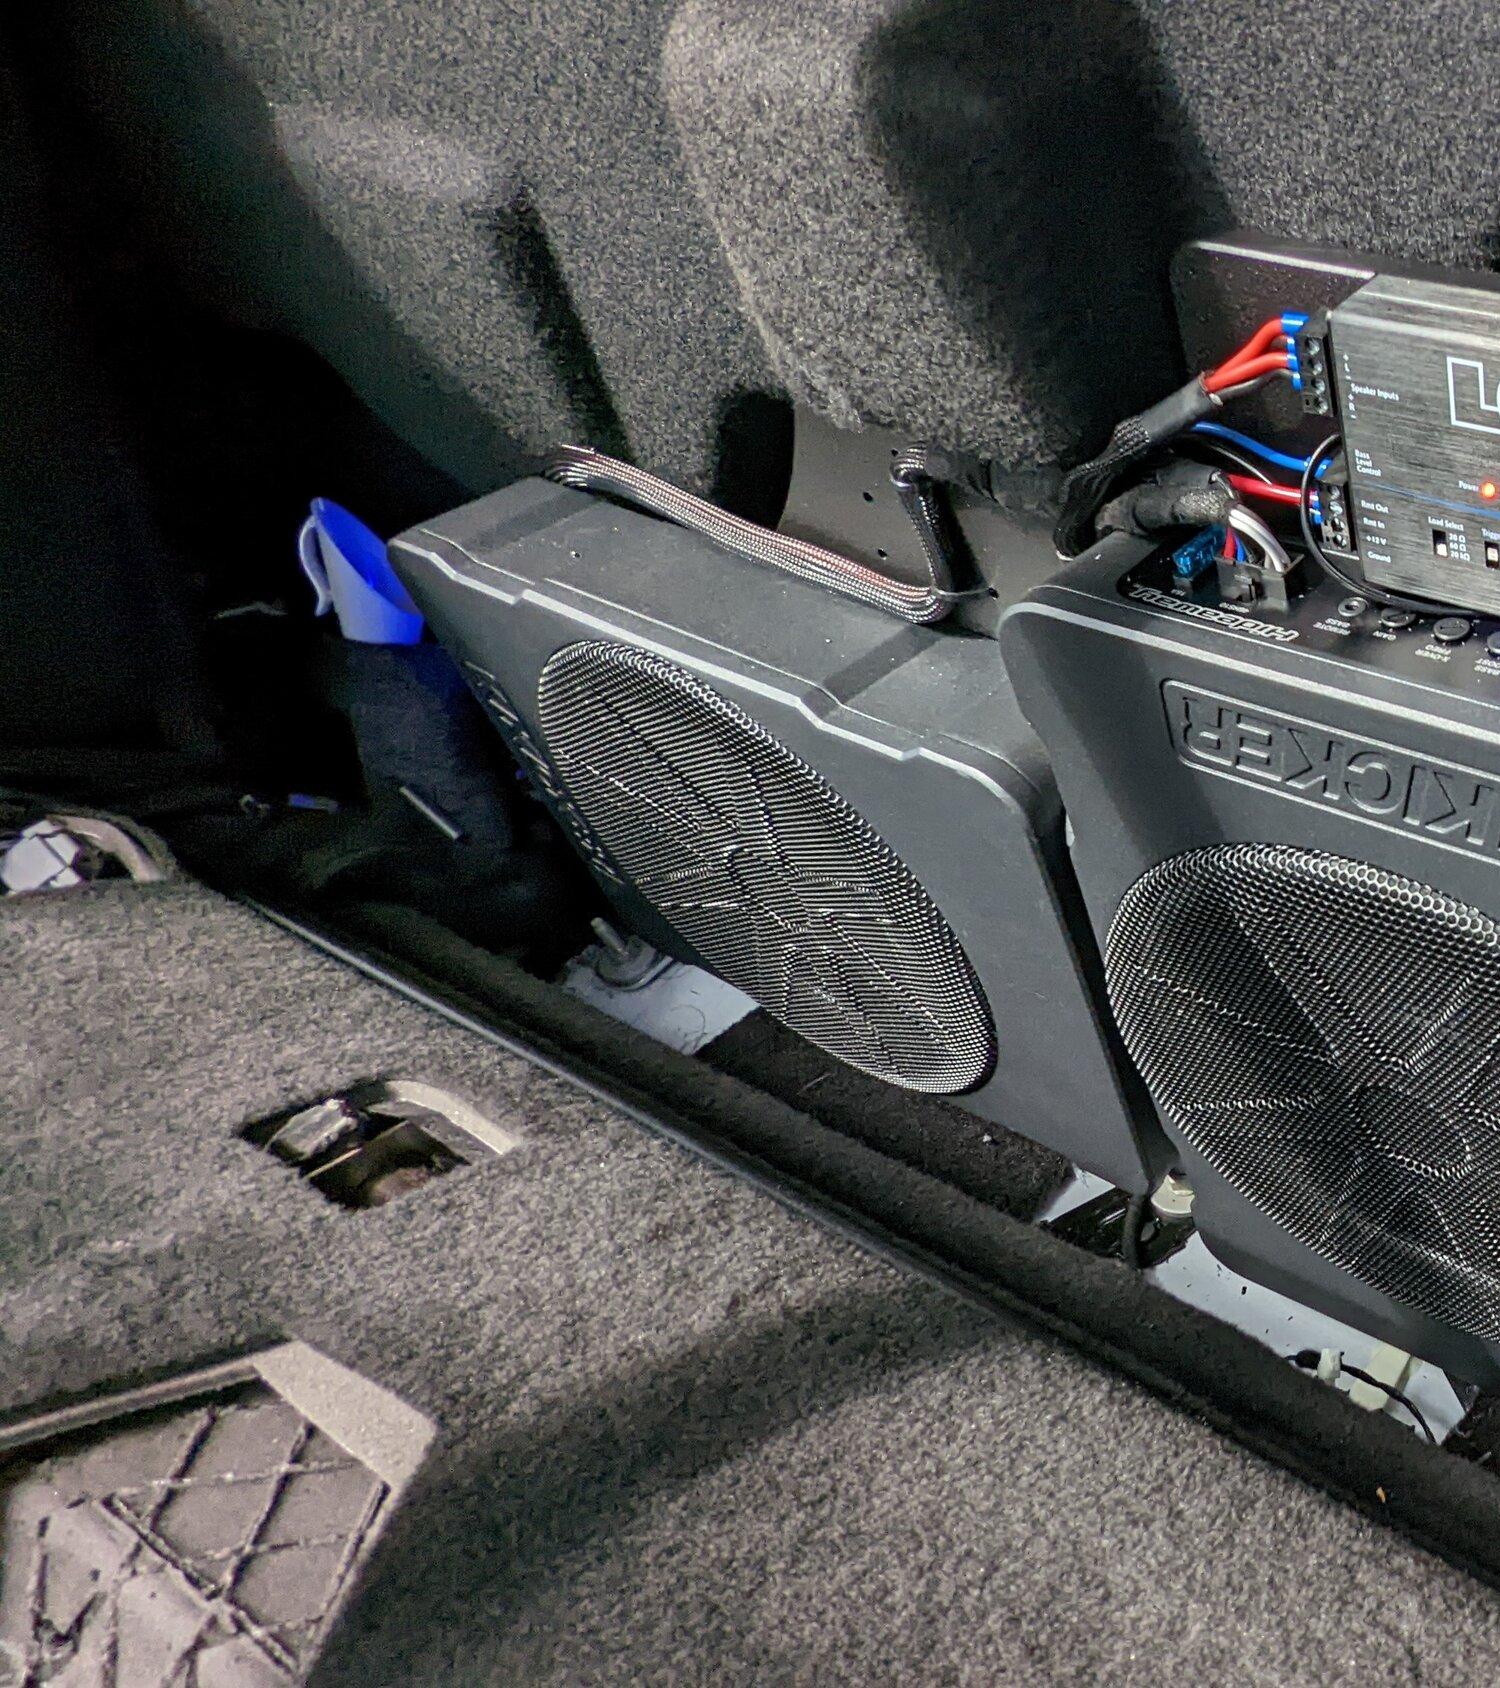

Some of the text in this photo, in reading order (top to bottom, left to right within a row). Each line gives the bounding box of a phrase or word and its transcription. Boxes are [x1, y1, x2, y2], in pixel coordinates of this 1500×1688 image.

[1350, 383, 1400, 401] Speaker Inputs
[1354, 449, 1370, 460] Bass
[1356, 458, 1372, 467] Level
[1356, 465, 1382, 477] Control
[1458, 480, 1480, 492] Power
[1361, 500, 1389, 514] Rmt Out
[1363, 517, 1385, 529] Rmt In
[1428, 516, 1464, 531] Load Select
[1367, 551, 1392, 563] Ground
[1313, 621, 1351, 636] REMOTE
[1372, 630, 1397, 642] GAIN
[1474, 665, 1500, 676] BASS
